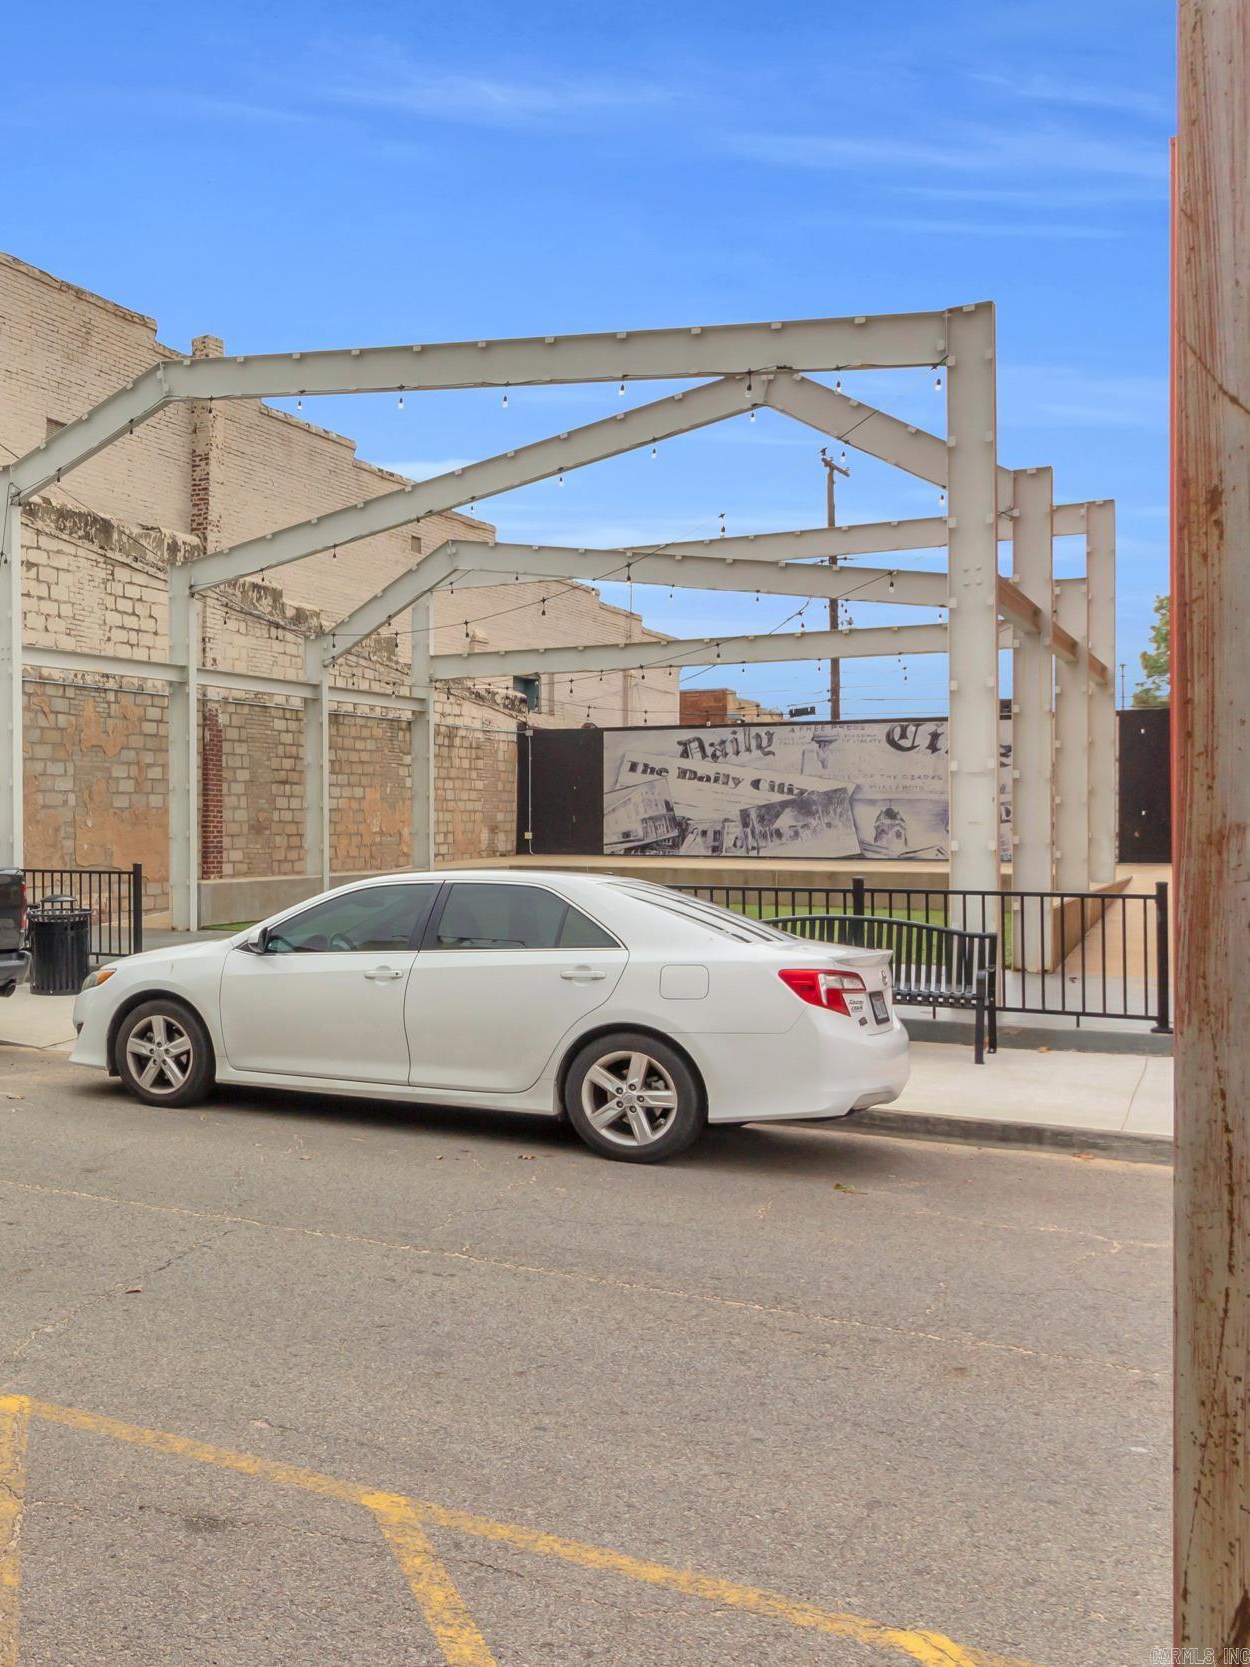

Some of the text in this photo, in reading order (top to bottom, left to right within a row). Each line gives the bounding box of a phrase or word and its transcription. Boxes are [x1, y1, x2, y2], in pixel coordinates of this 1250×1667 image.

[677, 722, 949, 762] Daily Ci
[627, 760, 816, 798] The Daily Citiz
